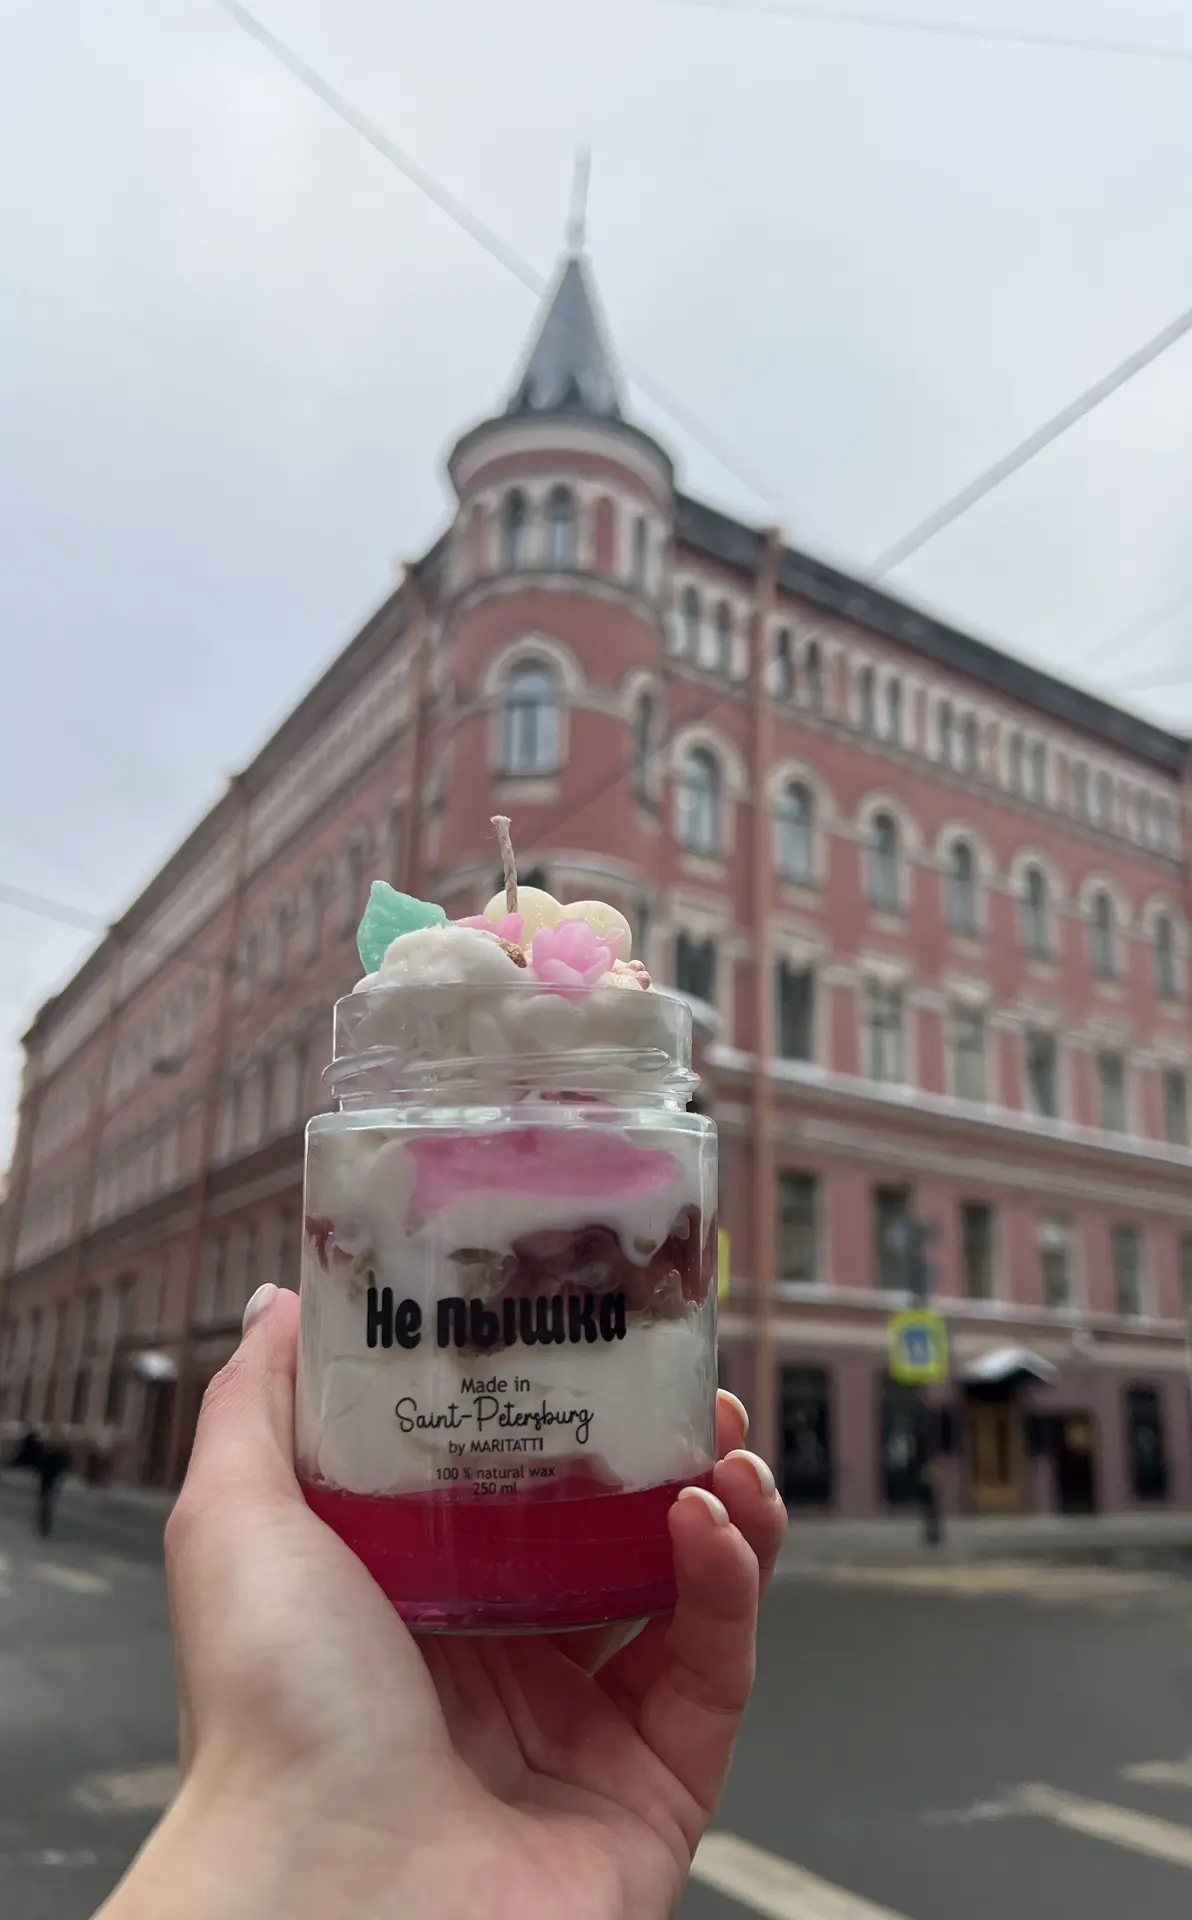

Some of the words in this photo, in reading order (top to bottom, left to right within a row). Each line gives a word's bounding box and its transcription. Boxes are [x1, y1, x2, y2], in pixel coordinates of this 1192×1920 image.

[366, 1286, 422, 1349] Не
[436, 1291, 627, 1348] пышка
[460, 1376, 509, 1394] Made
[514, 1376, 531, 1393] in
[395, 1395, 594, 1444] Saint-Petersburg
[448, 1440, 466, 1456] by
[470, 1437, 544, 1453] MARITATTI
[436, 1467, 459, 1480] 100
[476, 1465, 525, 1480] natural
[529, 1465, 556, 1478] wax
[472, 1482, 497, 1495] 250
[500, 1481, 517, 1495] ml
